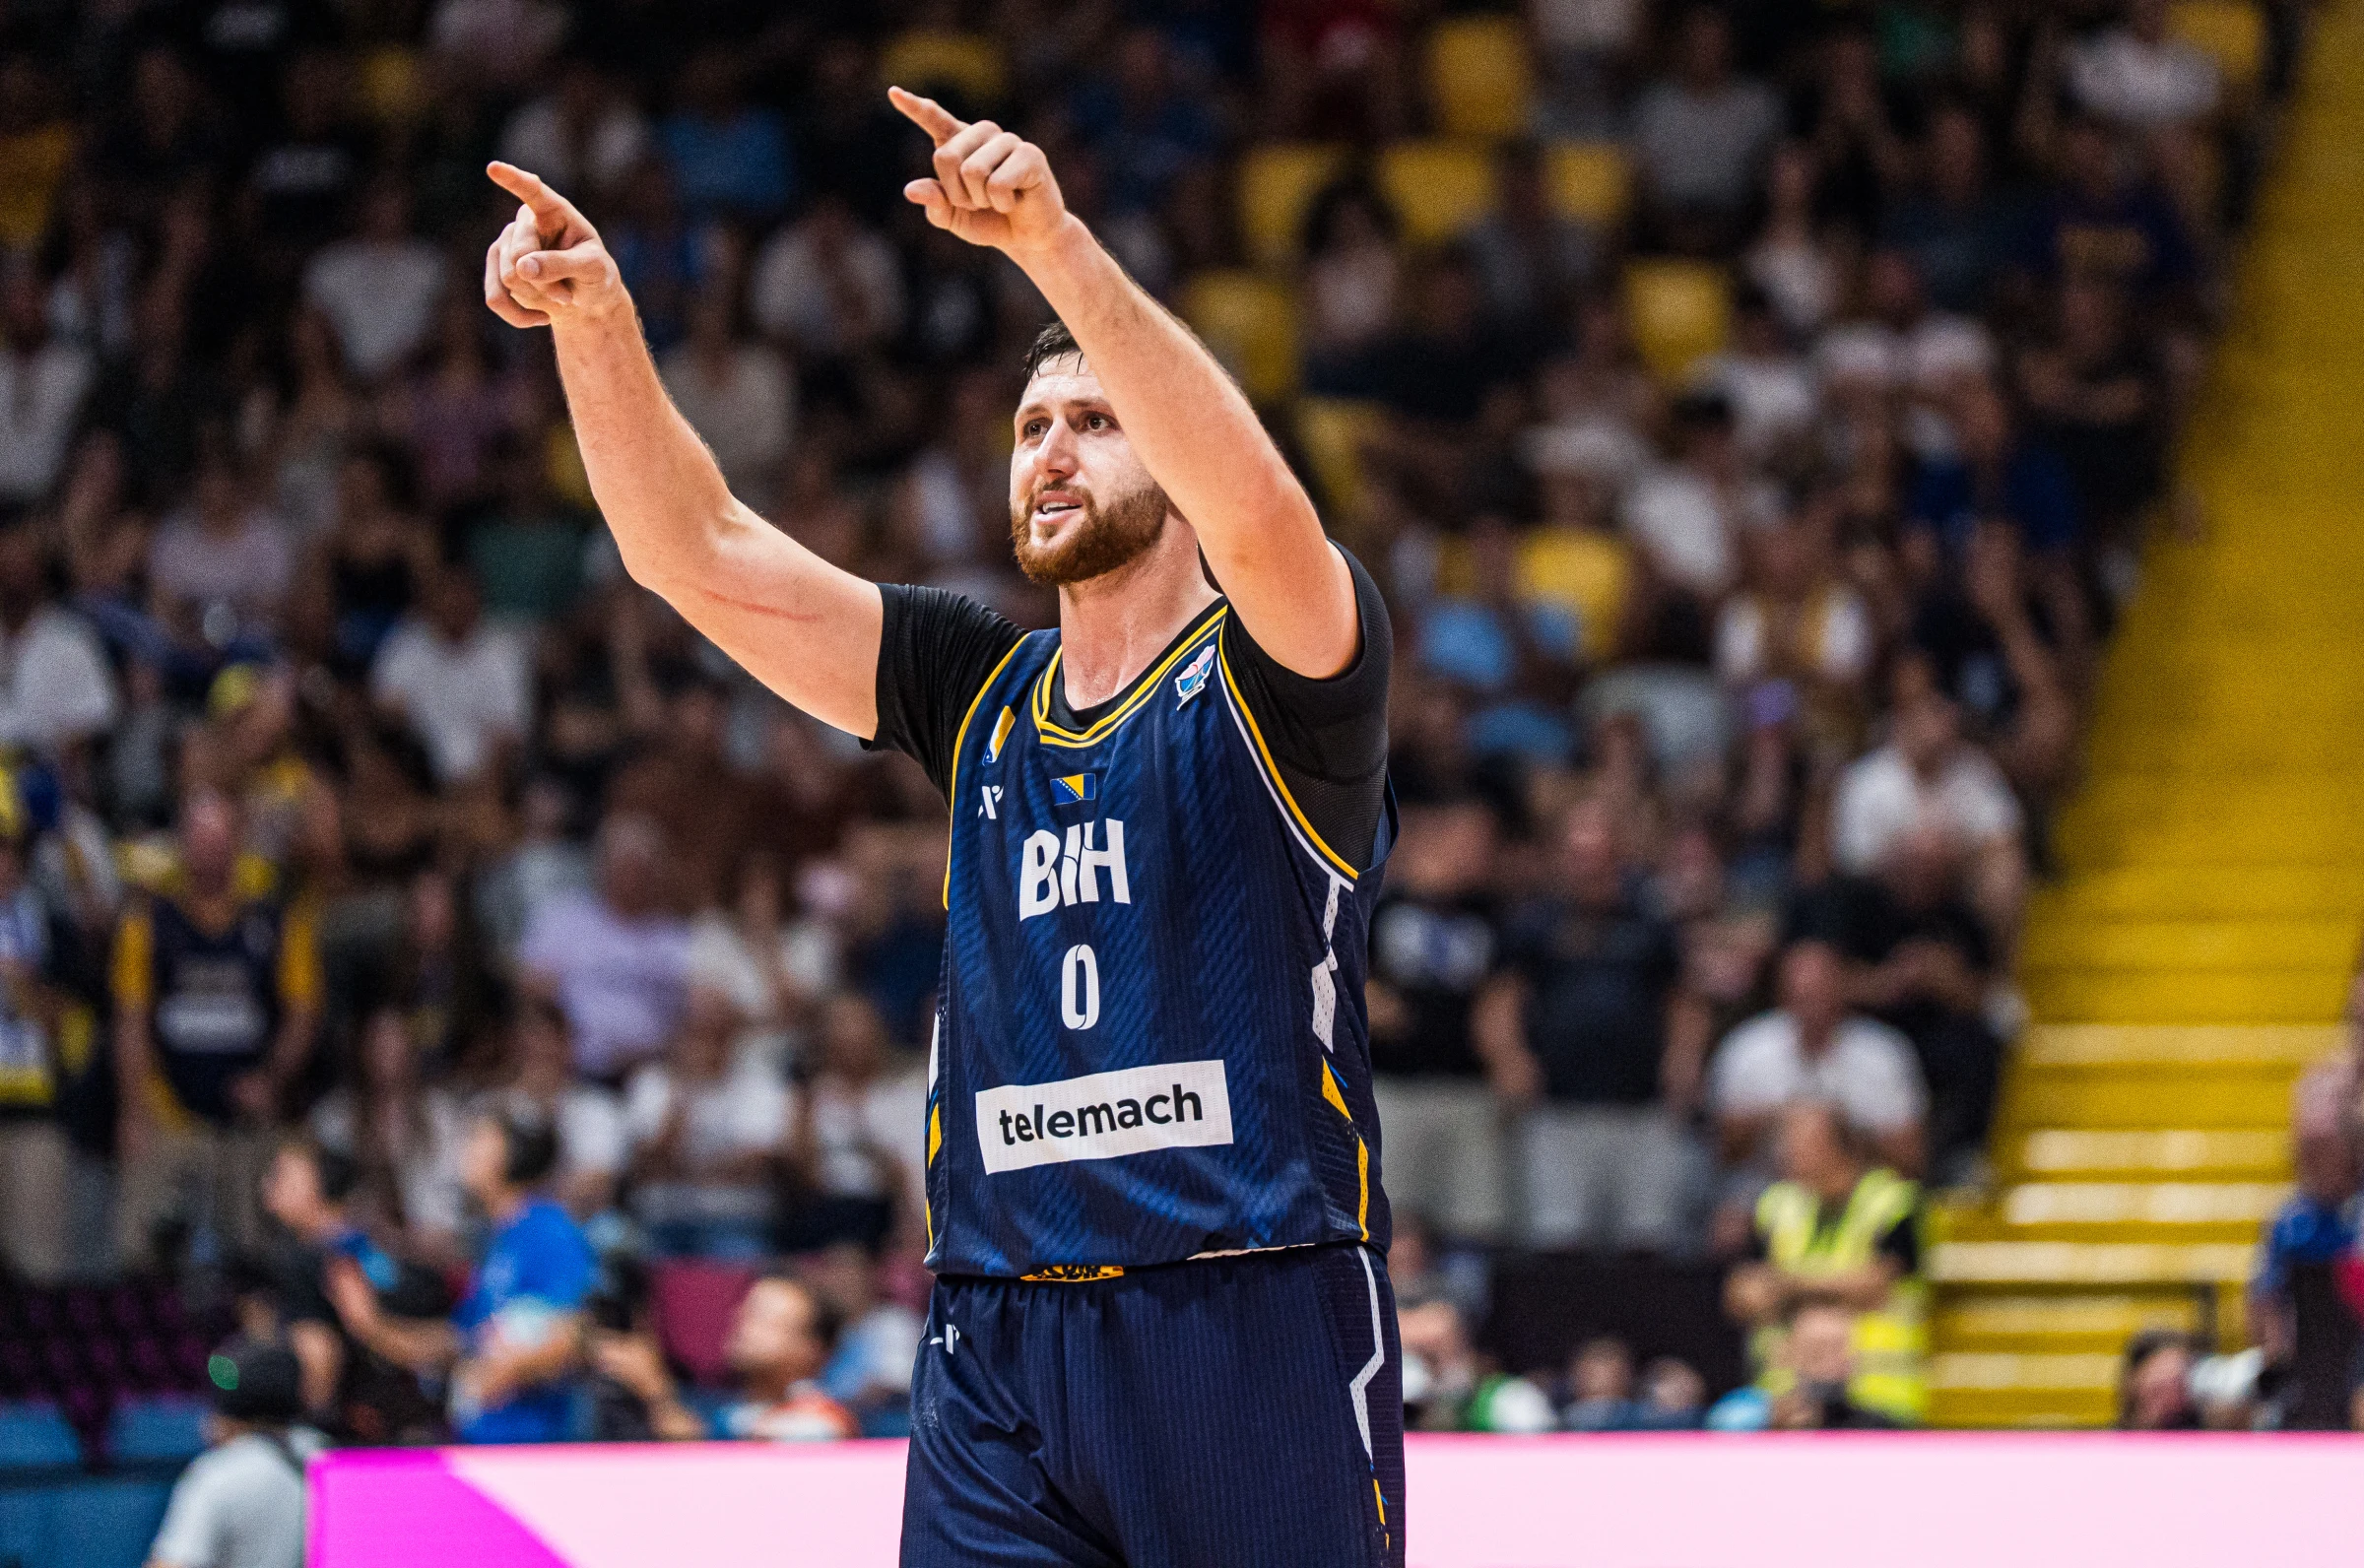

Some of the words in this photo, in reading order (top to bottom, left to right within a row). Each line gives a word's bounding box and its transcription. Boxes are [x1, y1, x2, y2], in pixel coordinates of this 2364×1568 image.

[1019, 818, 1131, 921] BIH
[1061, 944, 1100, 1030] 0
[999, 1083, 1203, 1145] telemach
